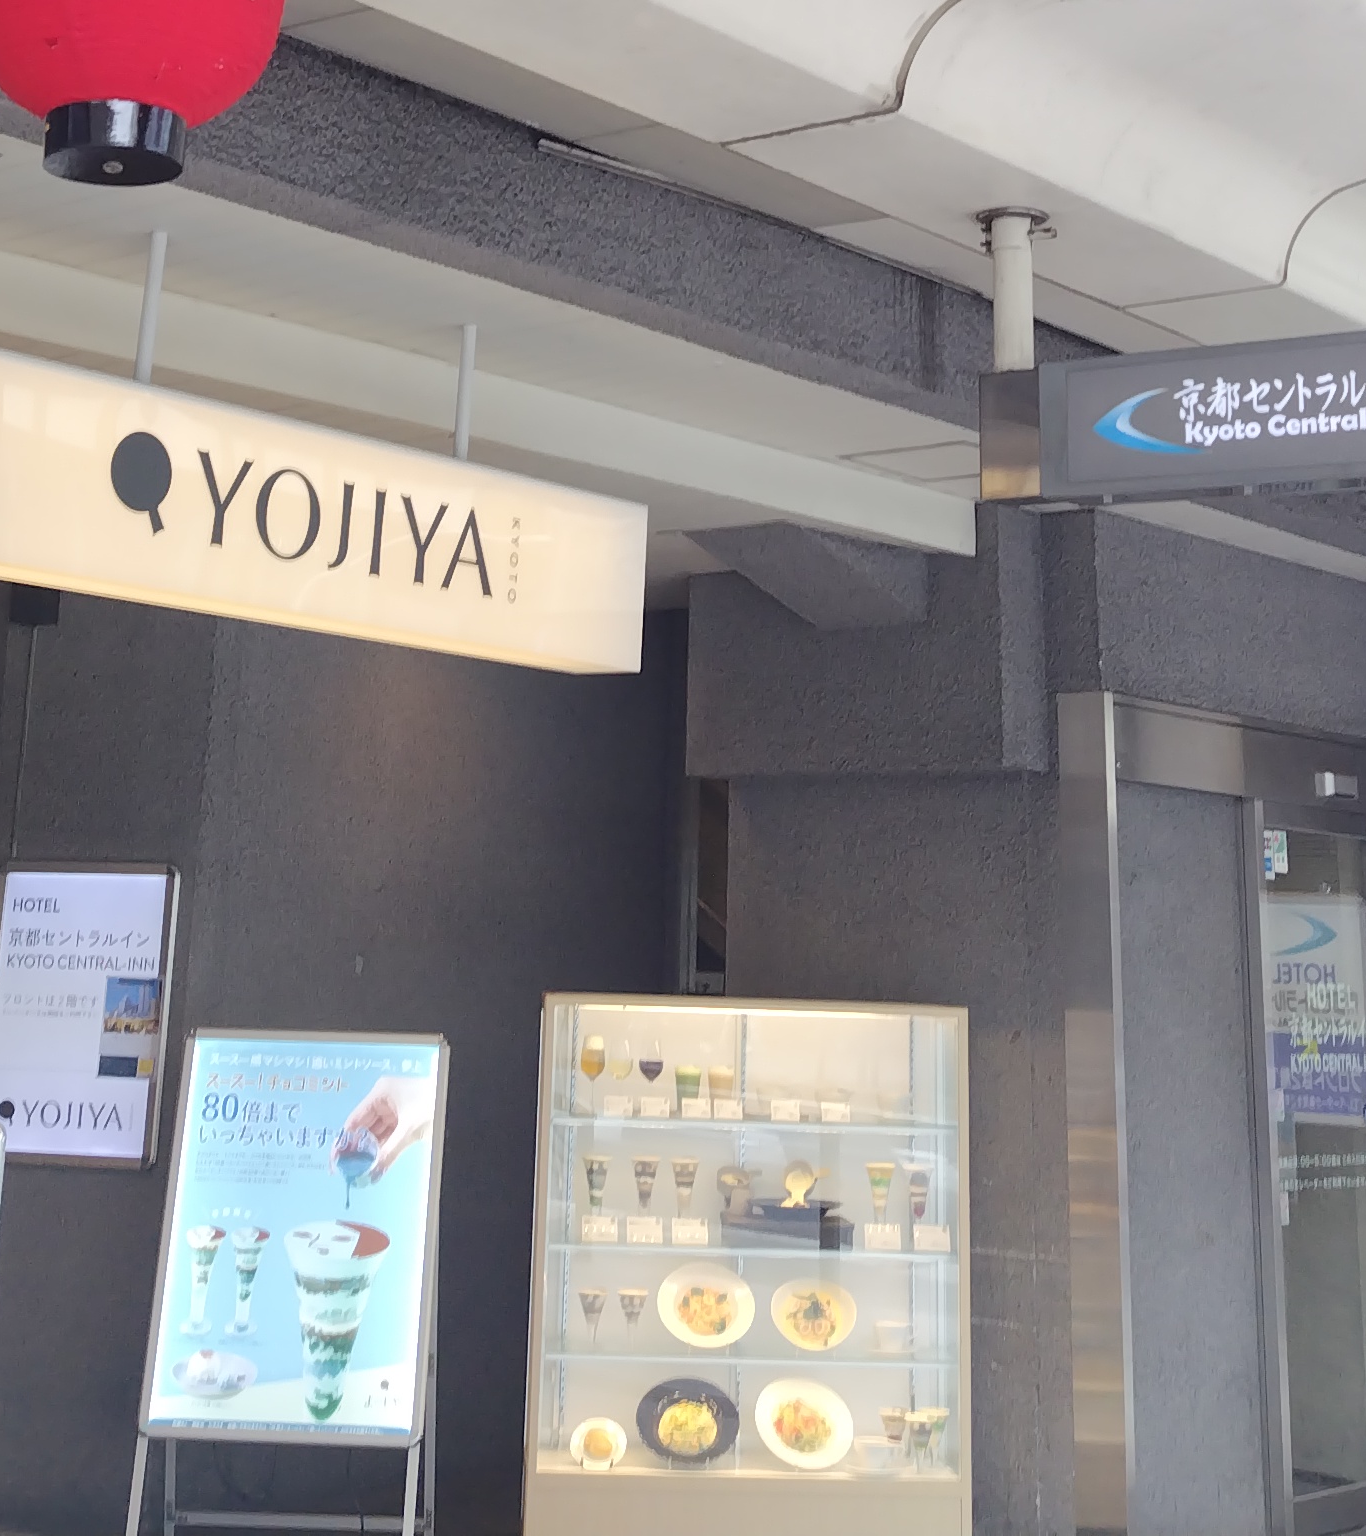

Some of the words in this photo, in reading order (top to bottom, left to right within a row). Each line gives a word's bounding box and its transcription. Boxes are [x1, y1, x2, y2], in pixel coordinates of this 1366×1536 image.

[1184, 417, 1261, 447] Kyoto
[1267, 407, 1366, 439] Central
[197, 447, 493, 599] YOJIYA
[507, 517, 521, 604] KYOTO
[12, 897, 60, 913] HOTEL
[8, 927, 150, 948] 京都セントラルイン
[7, 953, 54, 970] KYOTO
[1307, 982, 1355, 1010] HOTEL
[1290, 1053, 1322, 1073] KYOTO
[22, 1099, 123, 1132] YOJIYA
